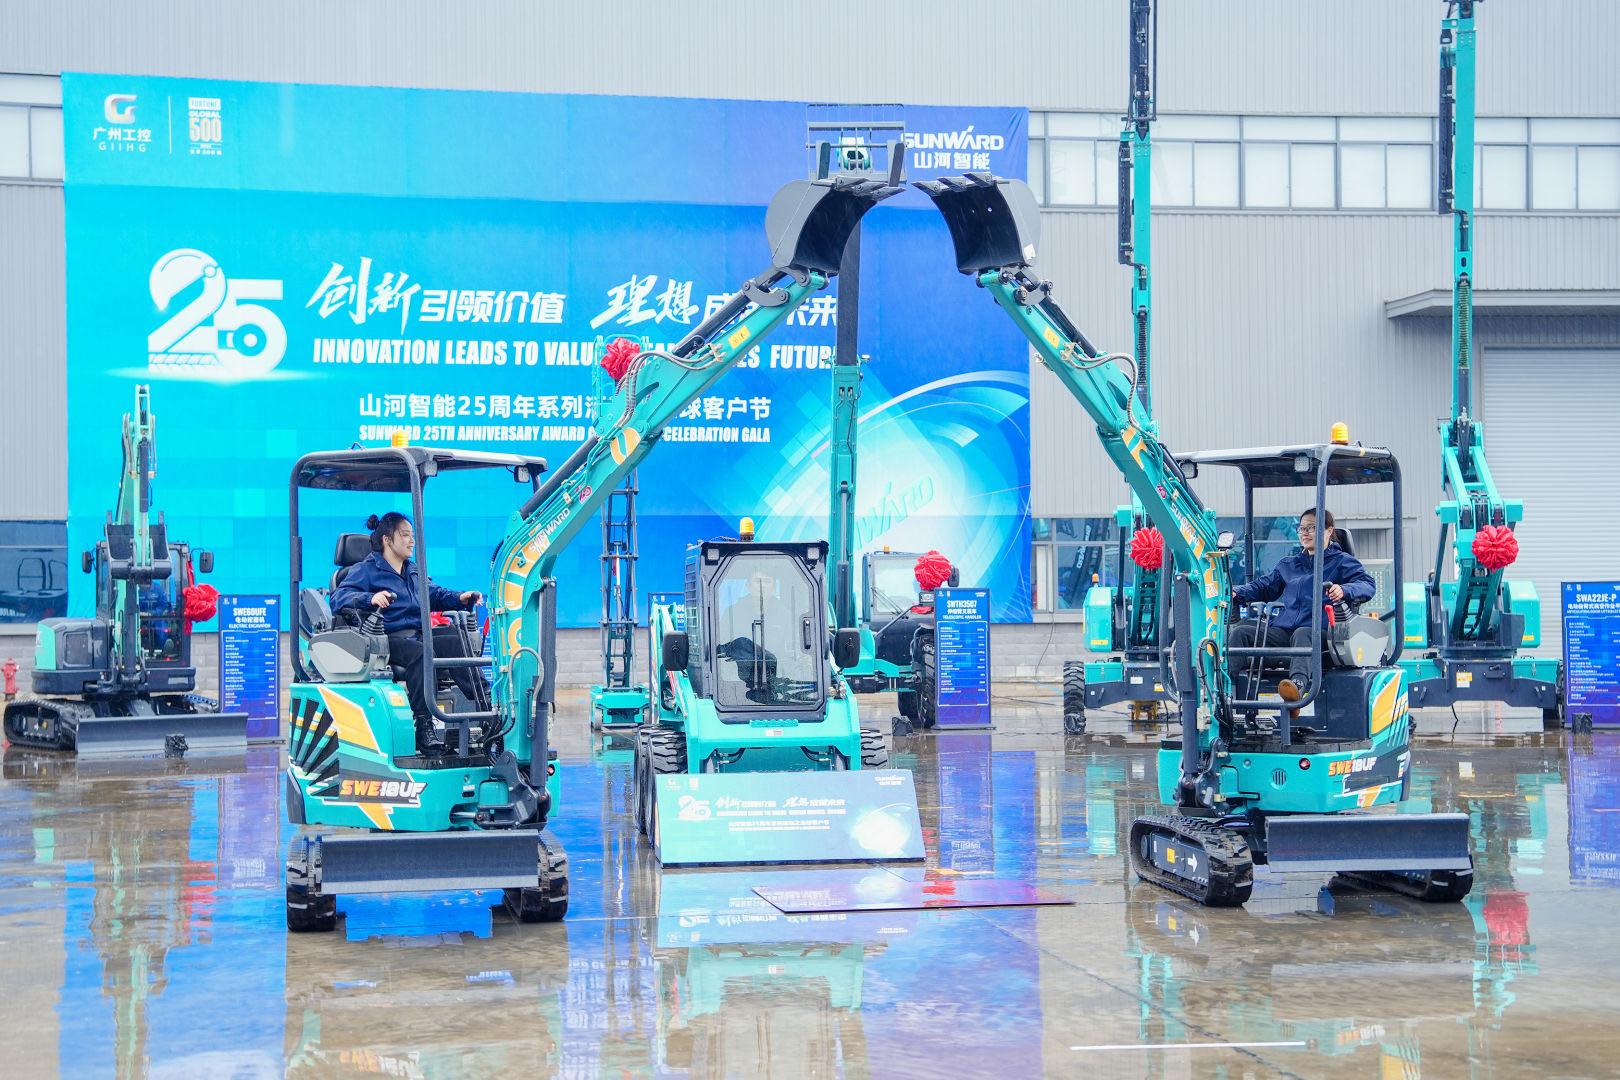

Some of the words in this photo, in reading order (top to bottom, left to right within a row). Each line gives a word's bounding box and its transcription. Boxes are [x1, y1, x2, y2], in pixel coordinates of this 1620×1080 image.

[189, 110, 221, 118] GLOBAL
[92, 126, 152, 143] 广州工控
[189, 118, 222, 143] 500
[901, 125, 1004, 150] SUNWARD
[98, 141, 147, 153] GIIHG
[914, 151, 990, 169] 山河智能
[305, 256, 567, 335] 创新引领价值
[148, 248, 287, 374] 25
[313, 338, 440, 364] INNOVATION
[445, 340, 508, 365] LEADS
[513, 341, 539, 366] TO
[544, 341, 598, 367] VALU
[769, 344, 836, 369] FUTUR
[423, 425, 456, 441] 25TH
[458, 426, 538, 441] ANNIVERSARY
[541, 426, 585, 441] AWARD
[663, 426, 739, 442] CELEBRATION
[741, 427, 771, 443] GALA
[340, 780, 426, 798] SWE18UF
